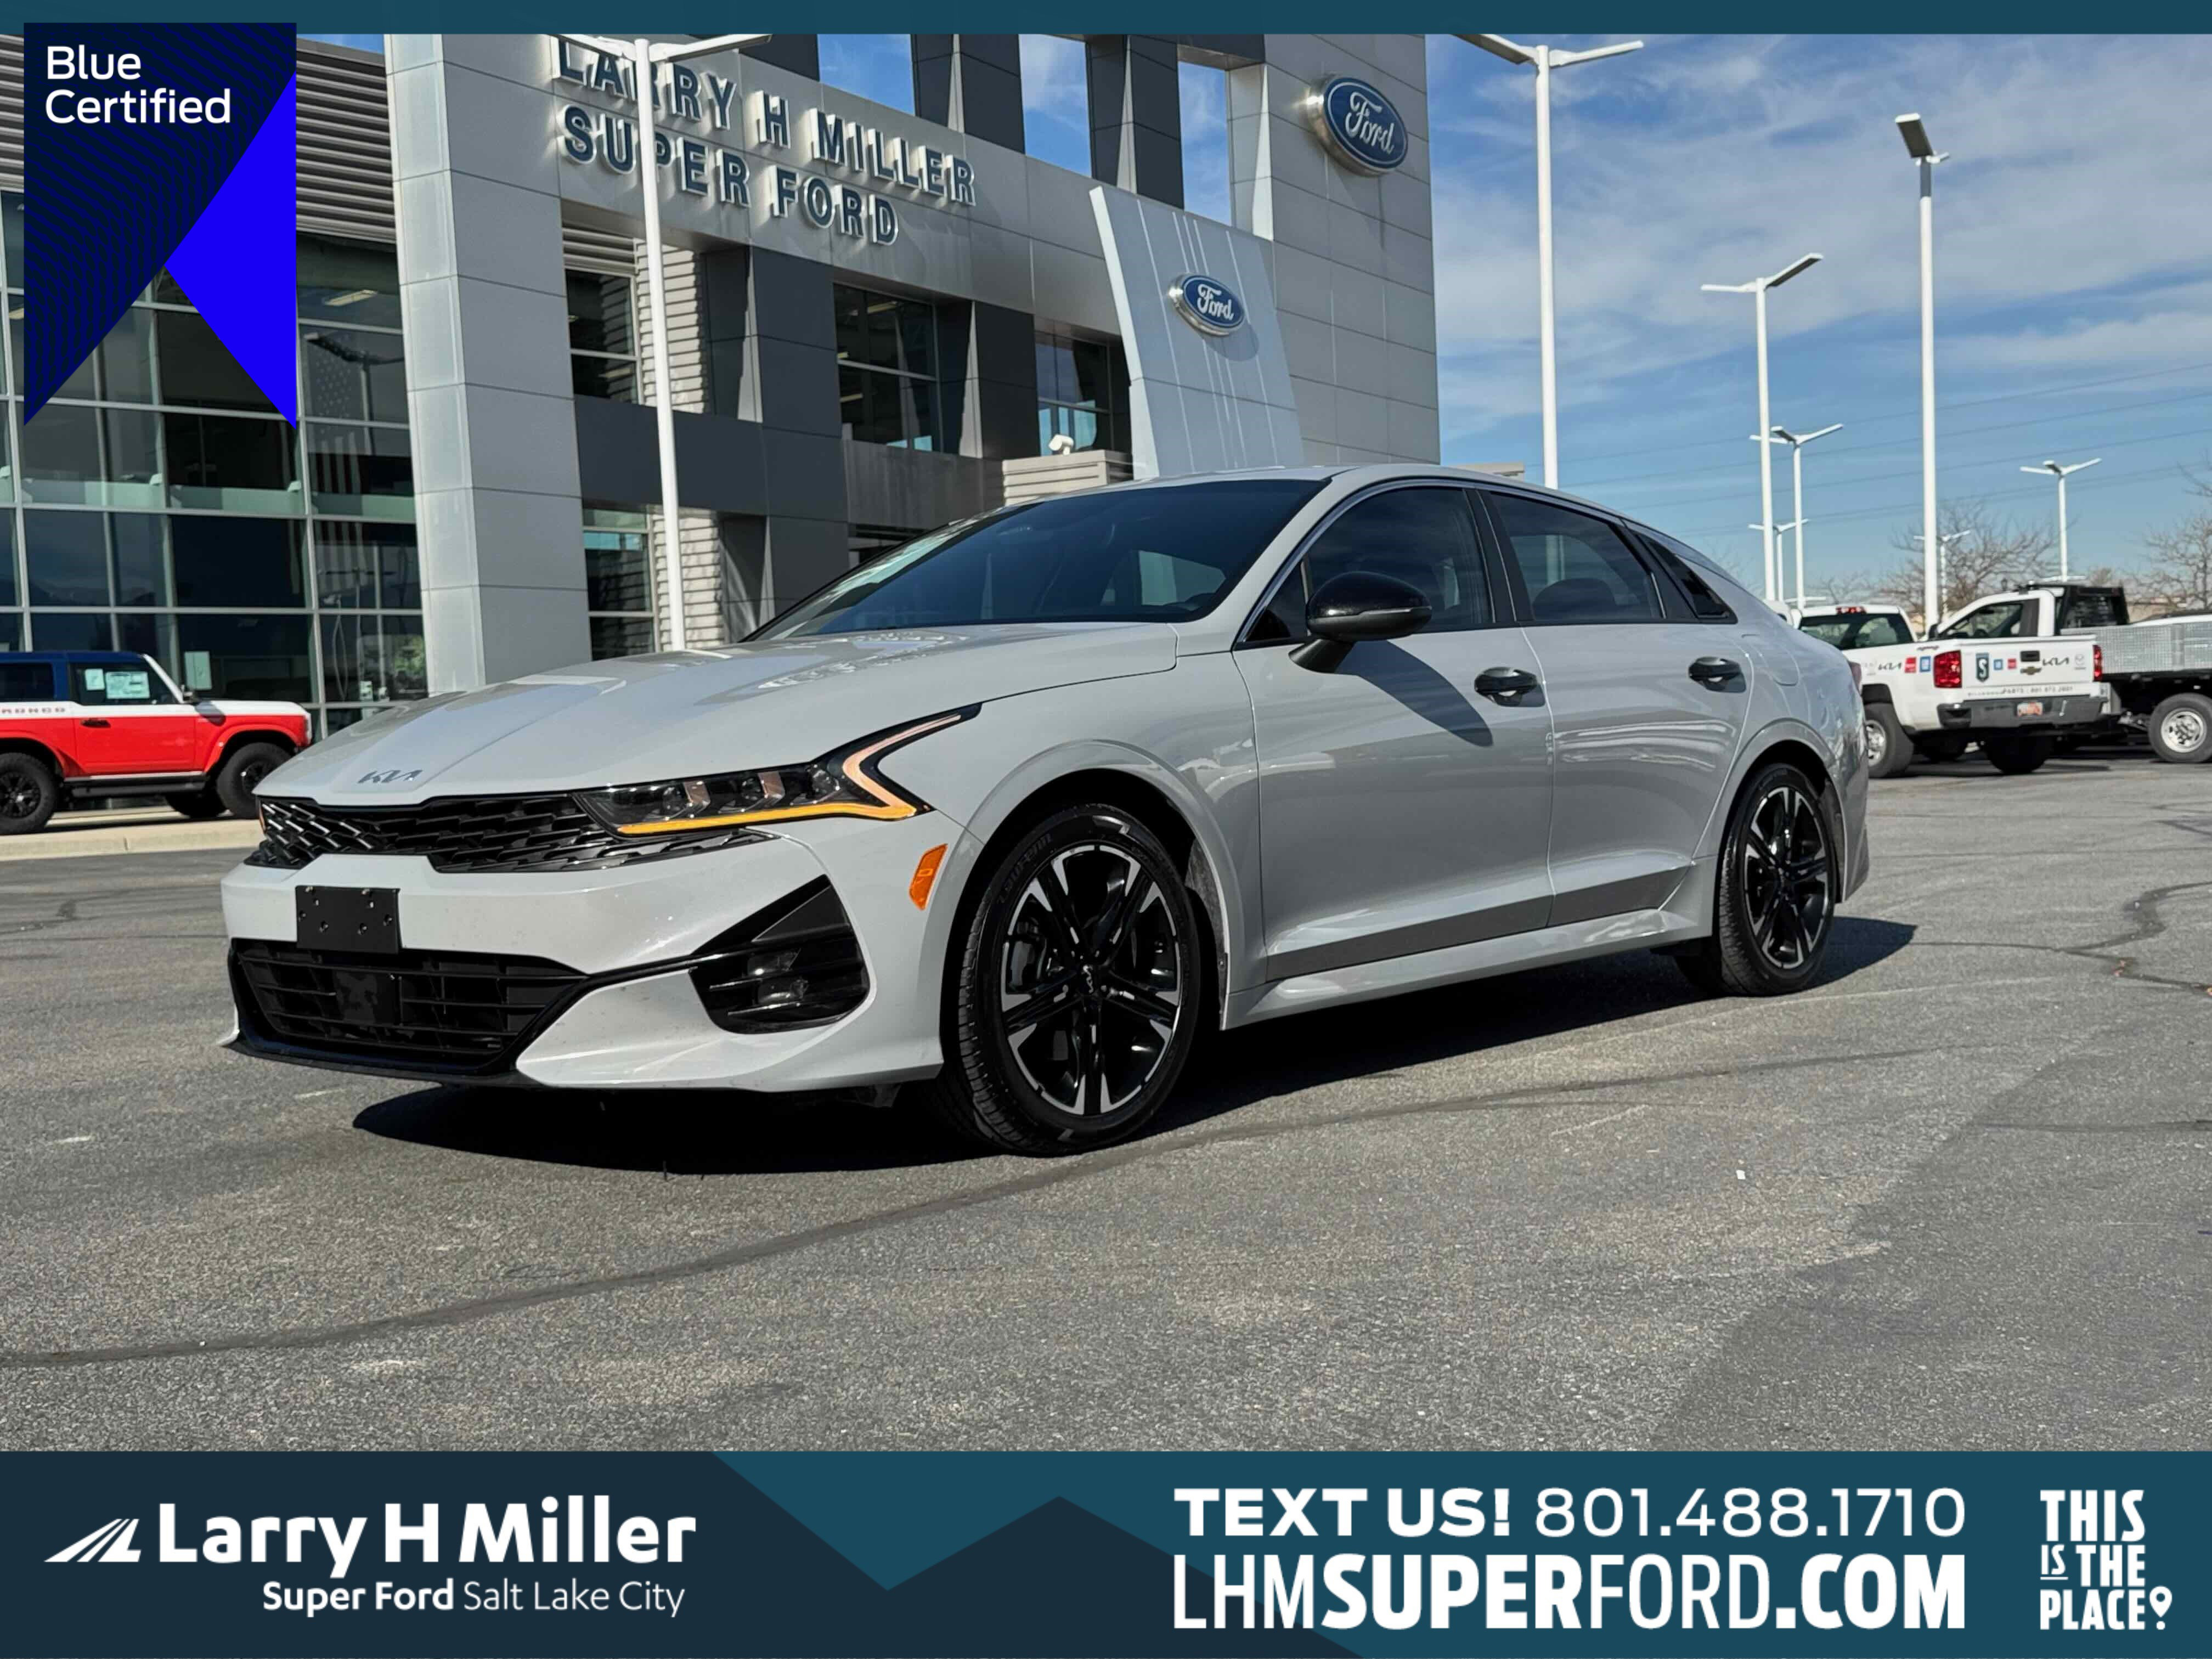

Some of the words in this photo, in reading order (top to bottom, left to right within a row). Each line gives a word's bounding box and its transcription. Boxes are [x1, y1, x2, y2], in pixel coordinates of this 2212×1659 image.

[754, 89, 791, 149] H
[808, 108, 977, 206] MILLER
[1345, 92, 1396, 154] Ford
[769, 165, 899, 246] FORD
[1197, 284, 1234, 321] Ford
